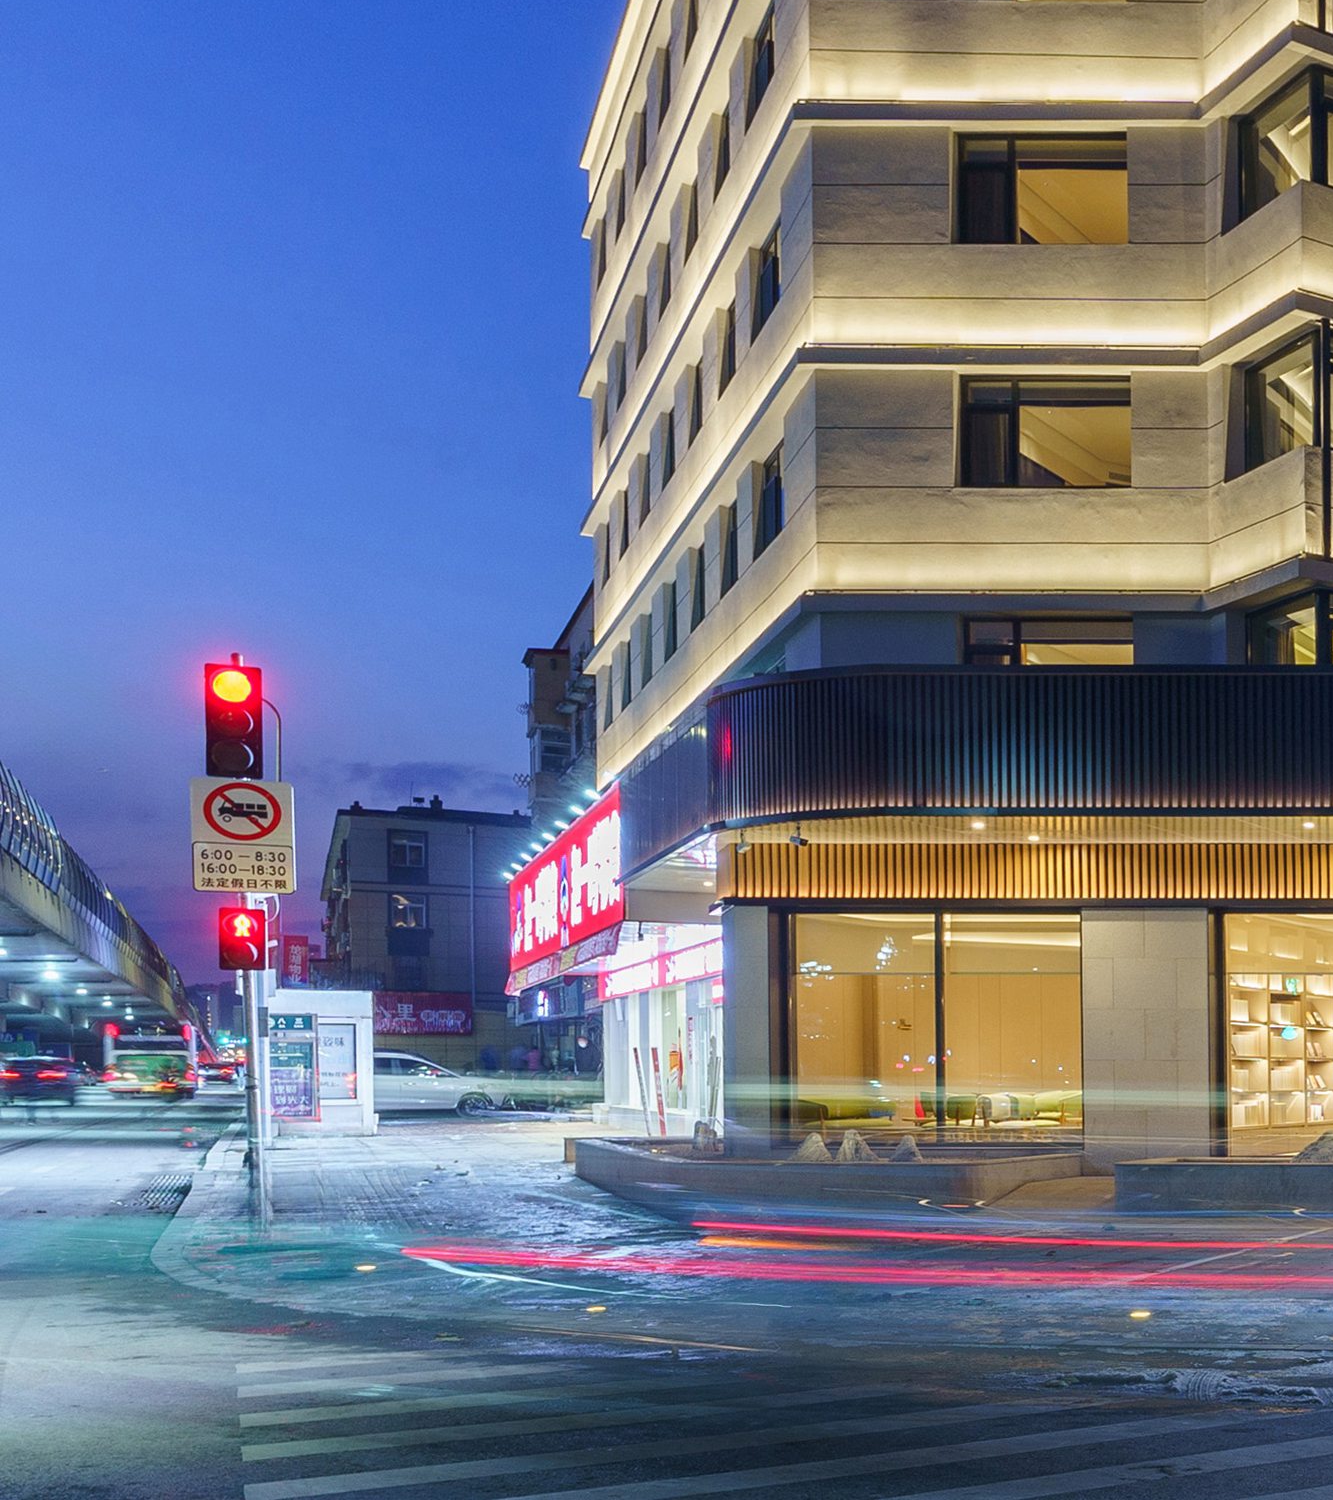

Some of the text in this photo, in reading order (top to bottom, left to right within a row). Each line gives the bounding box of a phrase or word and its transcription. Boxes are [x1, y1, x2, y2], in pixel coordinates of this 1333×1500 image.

[201, 877, 288, 890] 法定假日不限
